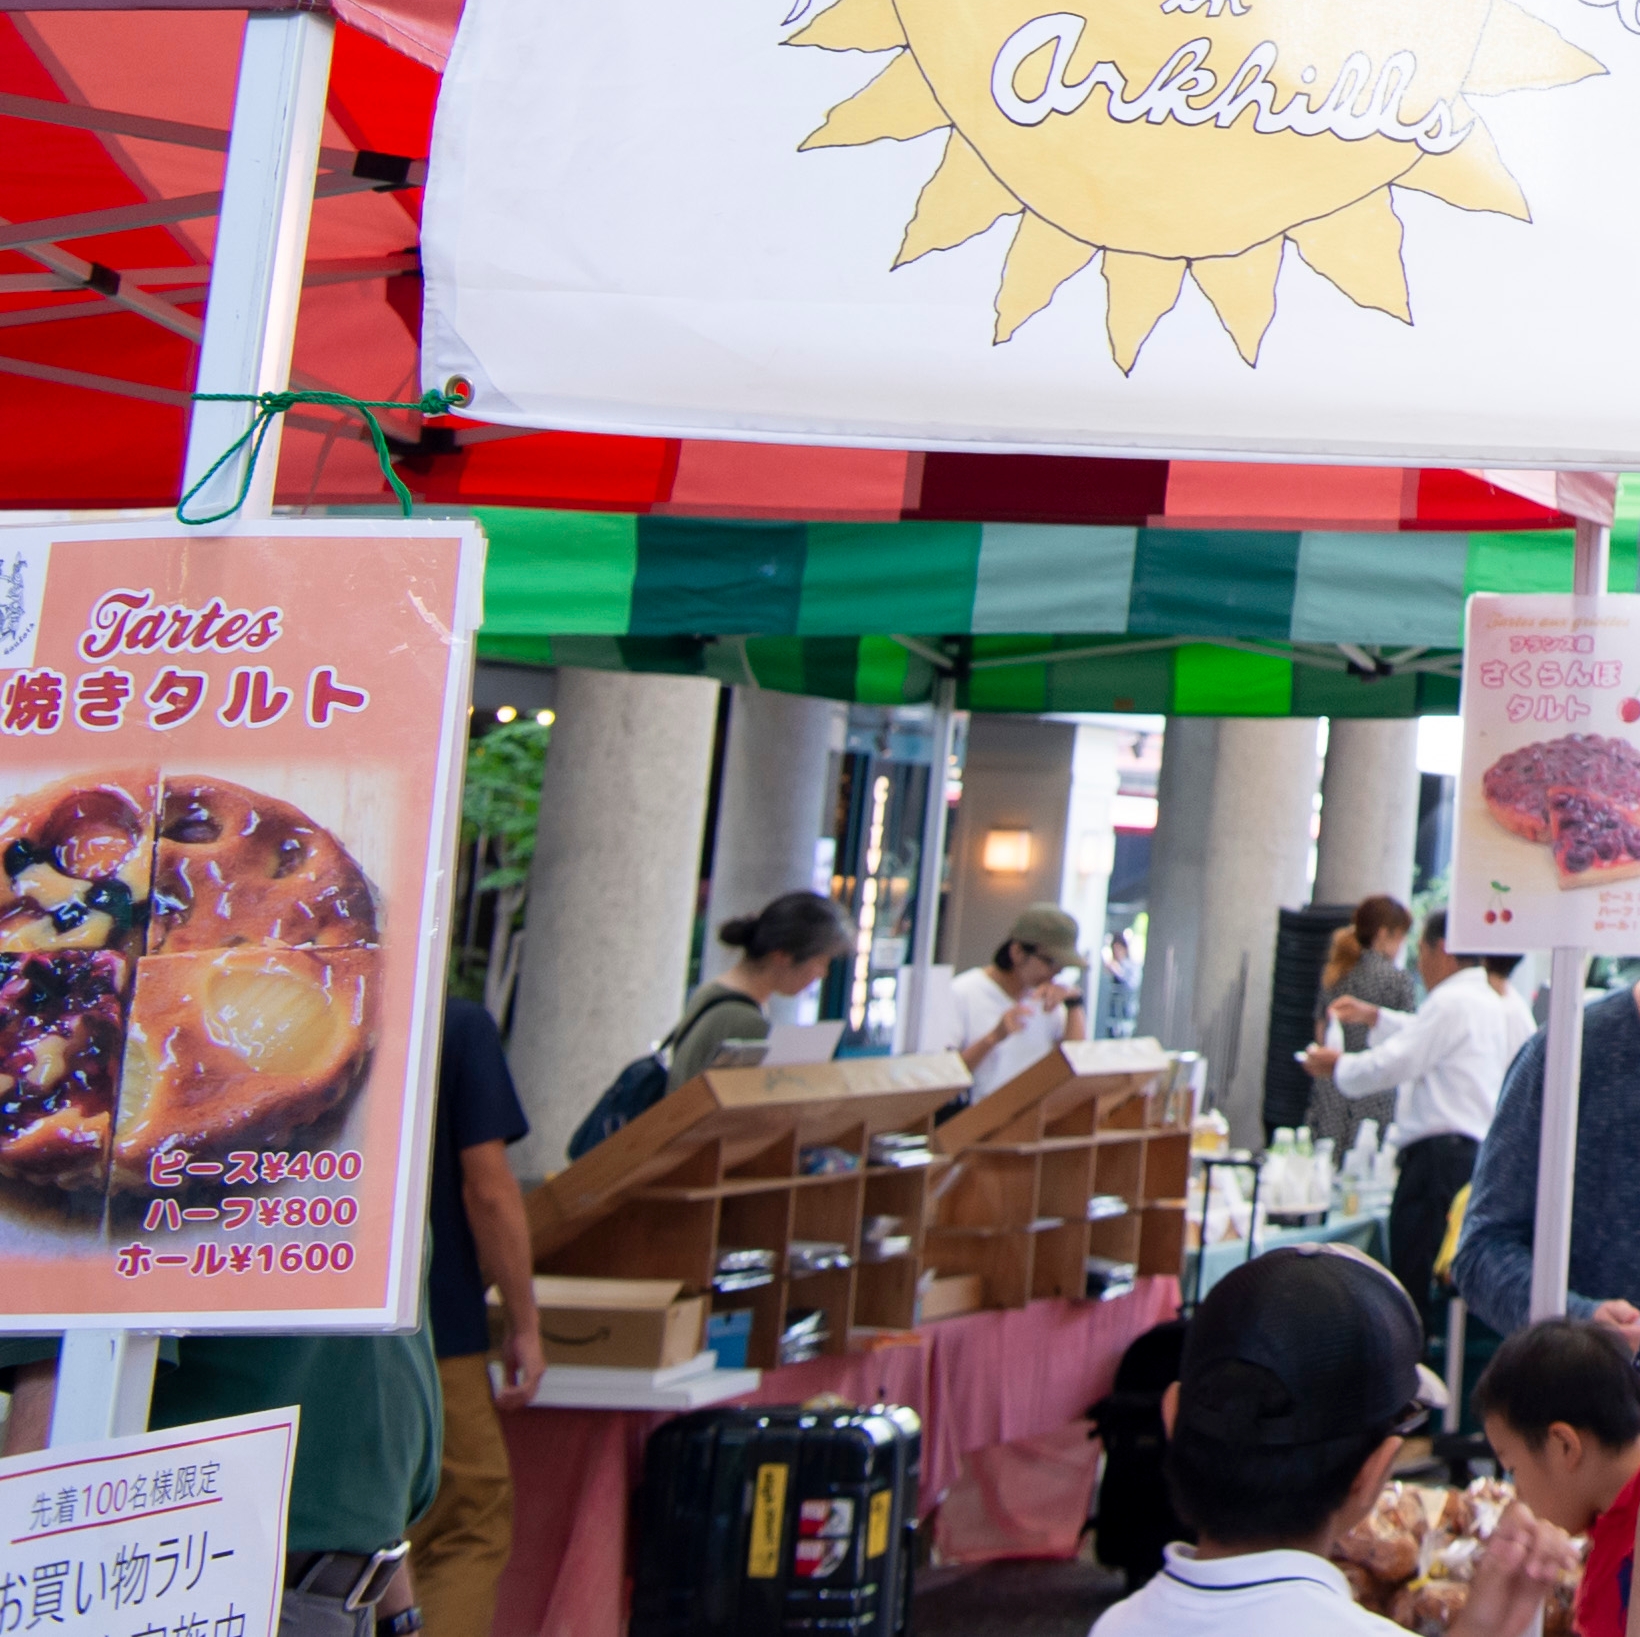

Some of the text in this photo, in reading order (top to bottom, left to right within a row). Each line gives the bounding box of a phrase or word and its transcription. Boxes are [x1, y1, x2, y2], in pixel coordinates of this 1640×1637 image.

[83, 593, 279, 658] Tartes
[4, 669, 366, 732] 焼きタルト
[1506, 693, 1592, 724] タルト
[151, 1151, 362, 1186] ピース¥400
[144, 1196, 358, 1231] ハーフ¥800
[115, 1242, 355, 1277] ホール¥1600
[29, 1460, 221, 1531] 先着100名様限定
